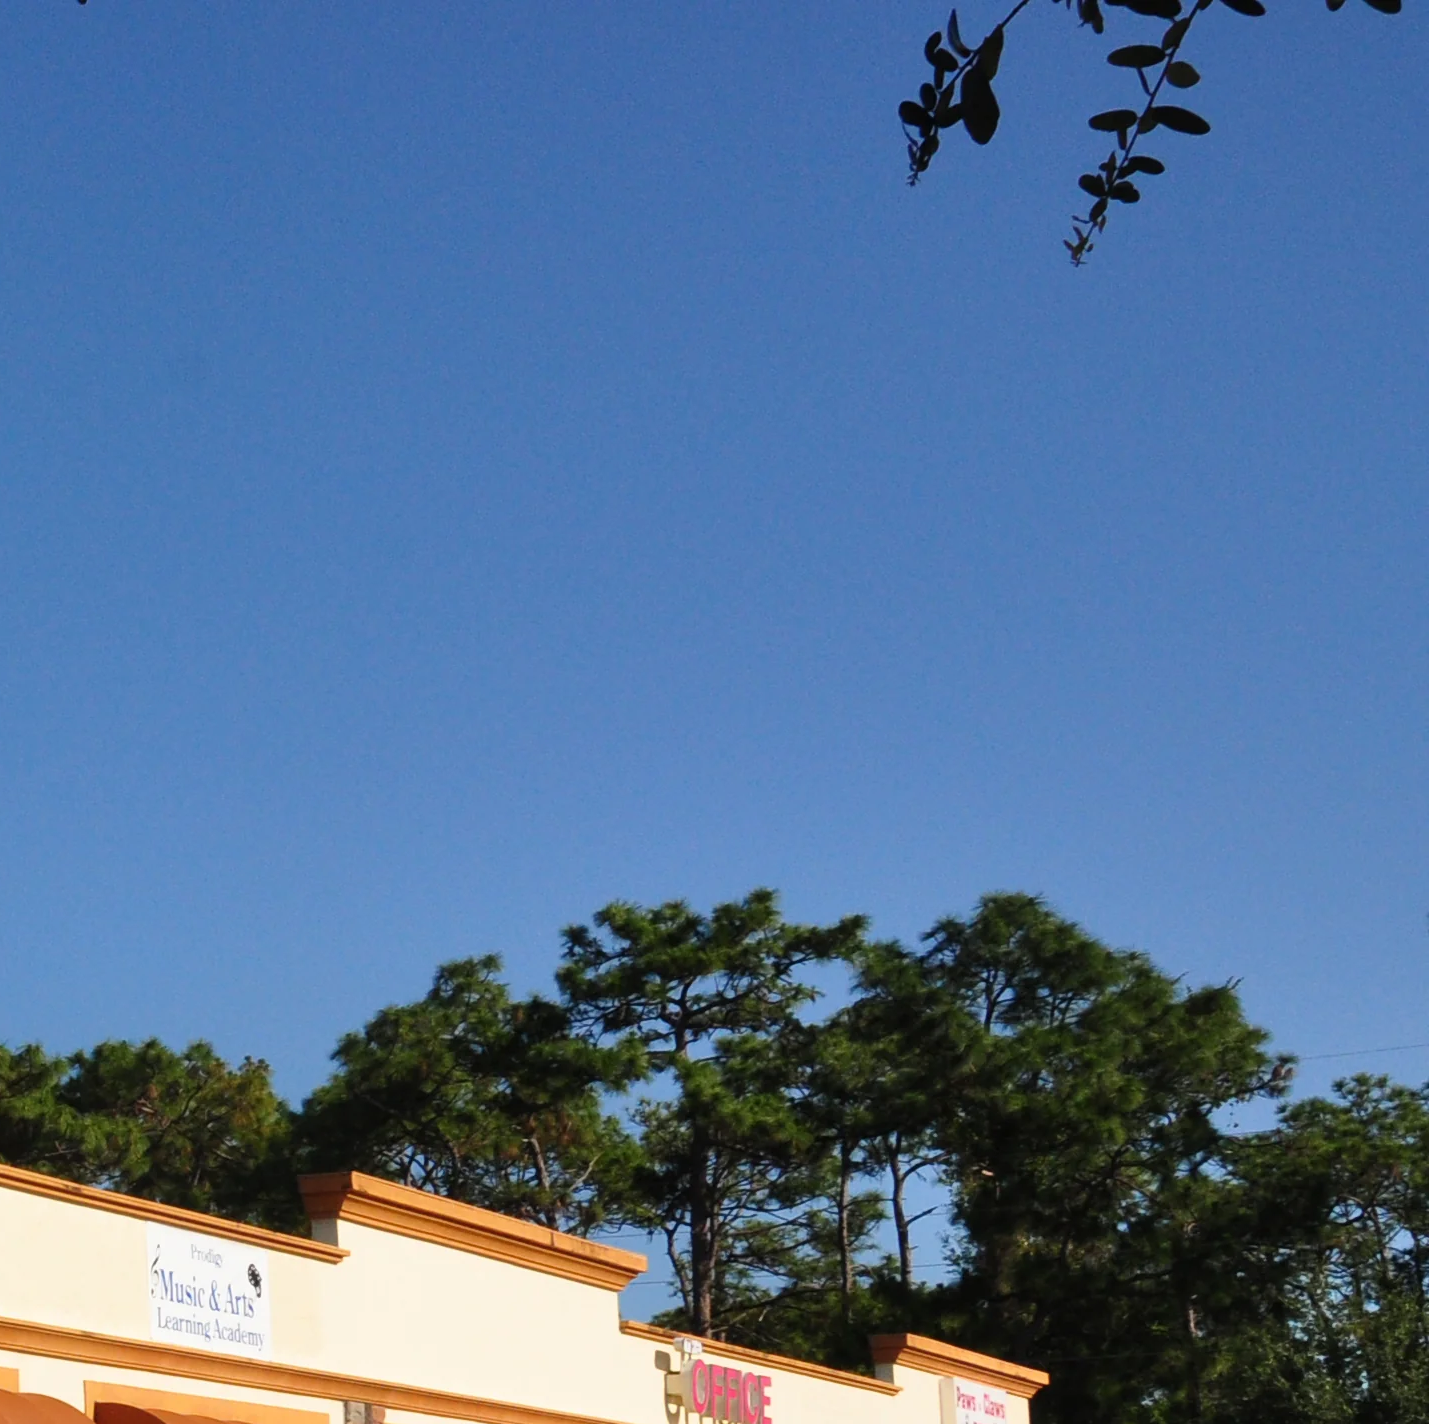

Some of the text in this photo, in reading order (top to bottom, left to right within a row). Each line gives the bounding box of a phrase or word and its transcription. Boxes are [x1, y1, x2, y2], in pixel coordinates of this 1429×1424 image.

[159, 1268, 254, 1319] Music & Arts
[157, 1306, 265, 1352] Learning Academy
